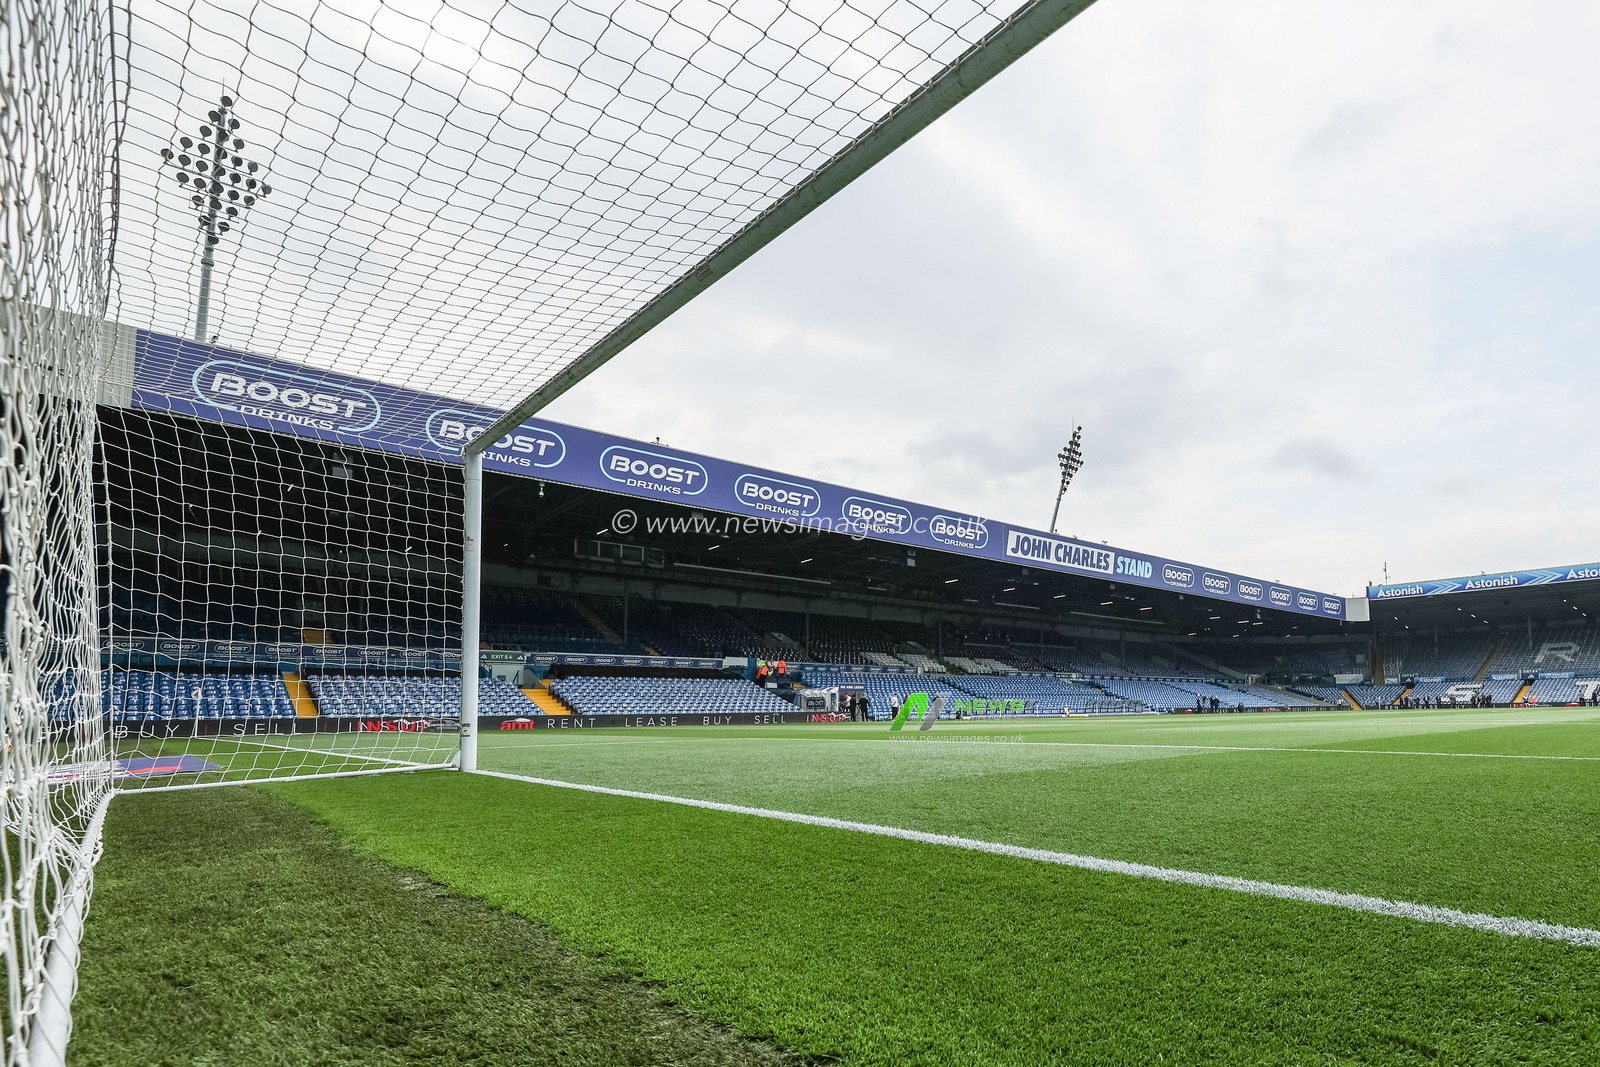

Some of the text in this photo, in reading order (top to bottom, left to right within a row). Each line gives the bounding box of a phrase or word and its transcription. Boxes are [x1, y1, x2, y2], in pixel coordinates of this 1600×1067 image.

[210, 373, 367, 418] BOOST
[239, 405, 335, 430] DRINKS
[480, 450, 531, 467] RINKS
[609, 455, 700, 485] BOOST
[626, 478, 682, 494] DRINKS
[742, 482, 815, 508] BOOST
[755, 502, 800, 517] DRINKS
[848, 504, 907, 526] BOOST
[858, 522, 896, 535] DRINKS
[935, 521, 984, 542] BOOST
[944, 538, 975, 549] DRINKS
[1010, 535, 1153, 579] JOHN CHARLES STAND
[1165, 569, 1192, 582] BOOST
[1464, 574, 1519, 590] Astonish
[1566, 568, 1600, 580] Asto
[1204, 577, 1229, 589] BOOST
[1240, 584, 1262, 596] BOOST
[1377, 584, 1424, 598] Astonish
[1271, 590, 1291, 602] BOOST
[1299, 596, 1317, 607] BOOST
[1324, 601, 1340, 611] BOOST
[500, 720, 534, 731] amt
[547, 718, 596, 729] RENT
[625, 717, 678, 728] LEASE
[703, 716, 733, 725] BUY
[754, 714, 787, 724] SELL
[115, 725, 180, 739] BUY
[233, 723, 302, 737] SELL
